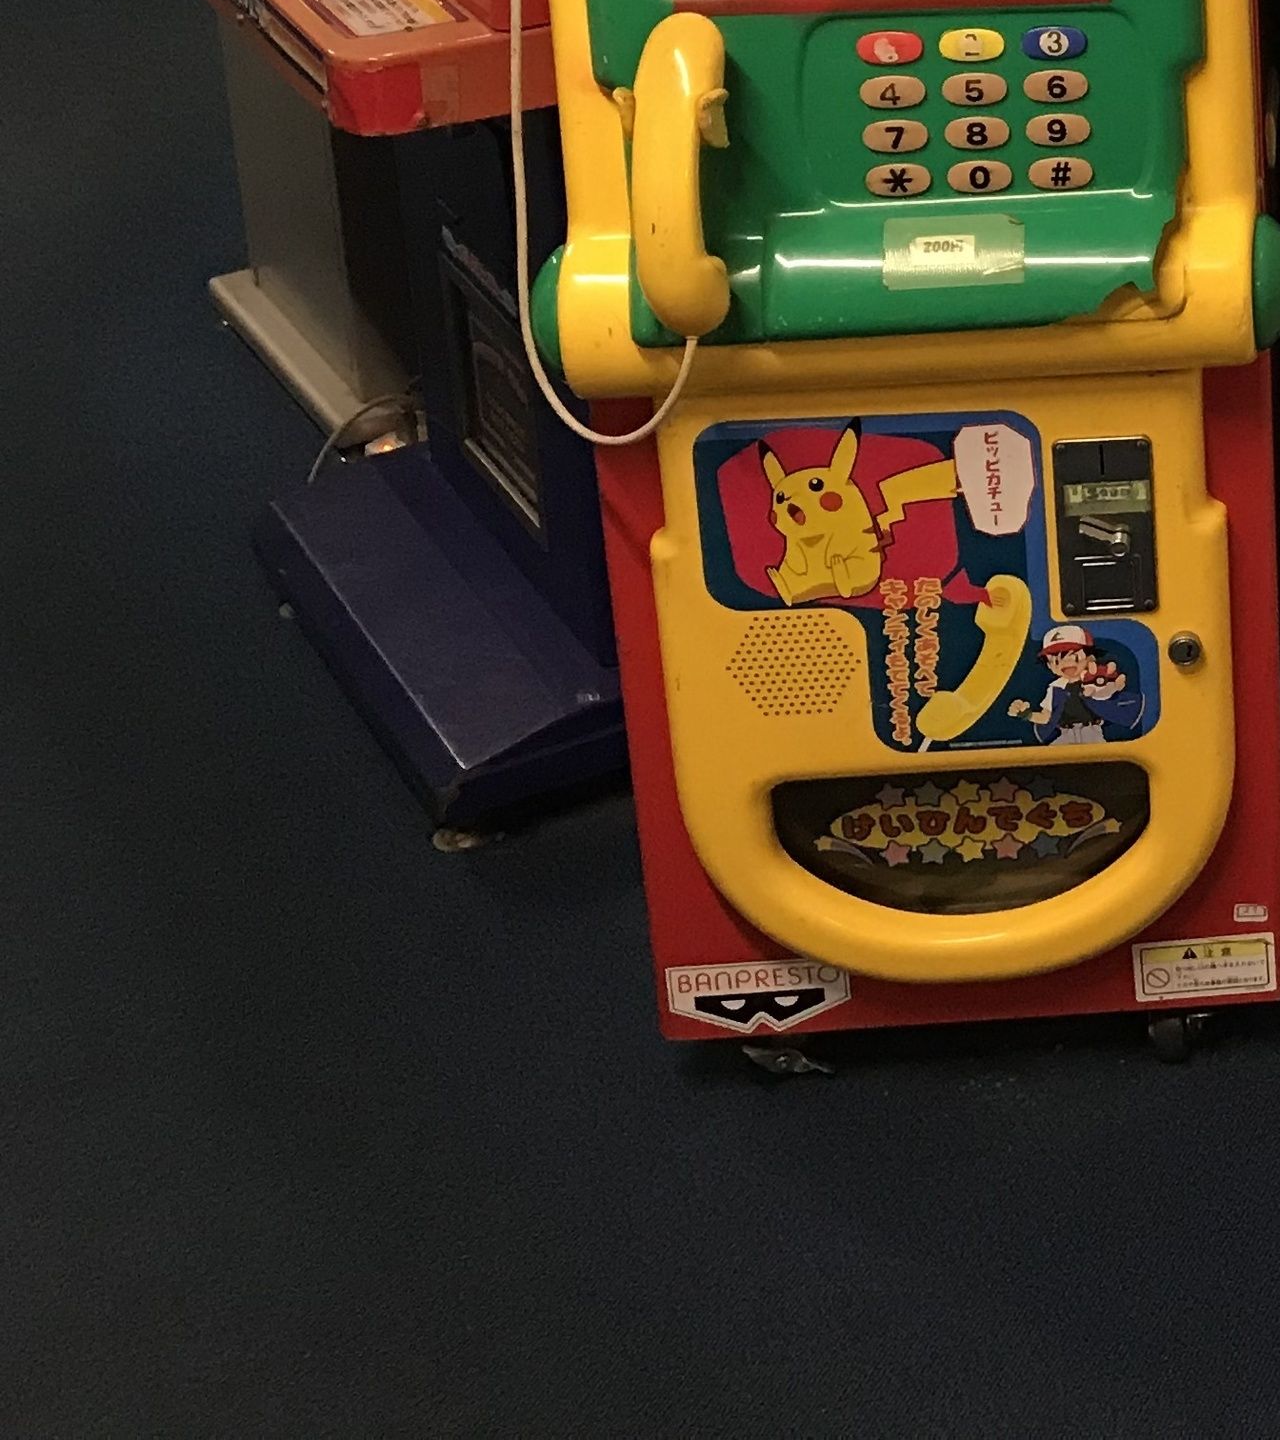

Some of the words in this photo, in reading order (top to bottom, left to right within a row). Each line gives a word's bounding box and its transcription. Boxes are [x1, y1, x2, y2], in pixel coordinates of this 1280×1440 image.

[1046, 31, 1064, 54] 3
[879, 82, 901, 106] 4
[964, 79, 985, 103] 5
[1047, 75, 1068, 99] 6
[884, 126, 905, 150] 7
[965, 121, 989, 146] 8
[1046, 118, 1068, 143] 9
[968, 165, 991, 190] 0
[842, 798, 1096, 841] けいひんでぐち
[678, 963, 840, 996] BANPRESTO
